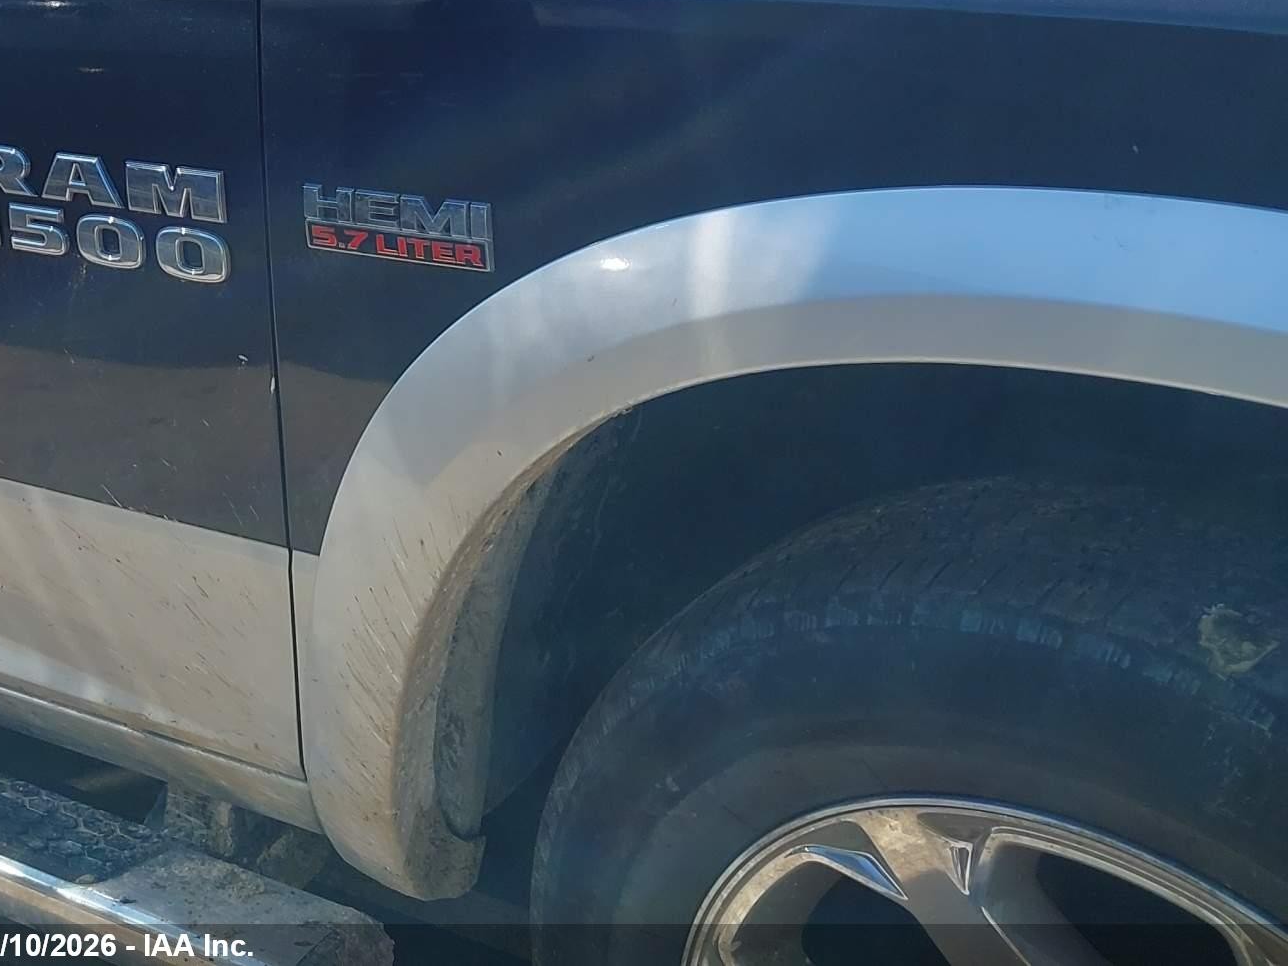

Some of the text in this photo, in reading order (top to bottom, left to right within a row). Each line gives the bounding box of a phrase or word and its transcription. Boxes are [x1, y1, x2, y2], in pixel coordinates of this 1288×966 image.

[302, 183, 493, 241] HEMI
[311, 224, 484, 268] 5.7 LITER
